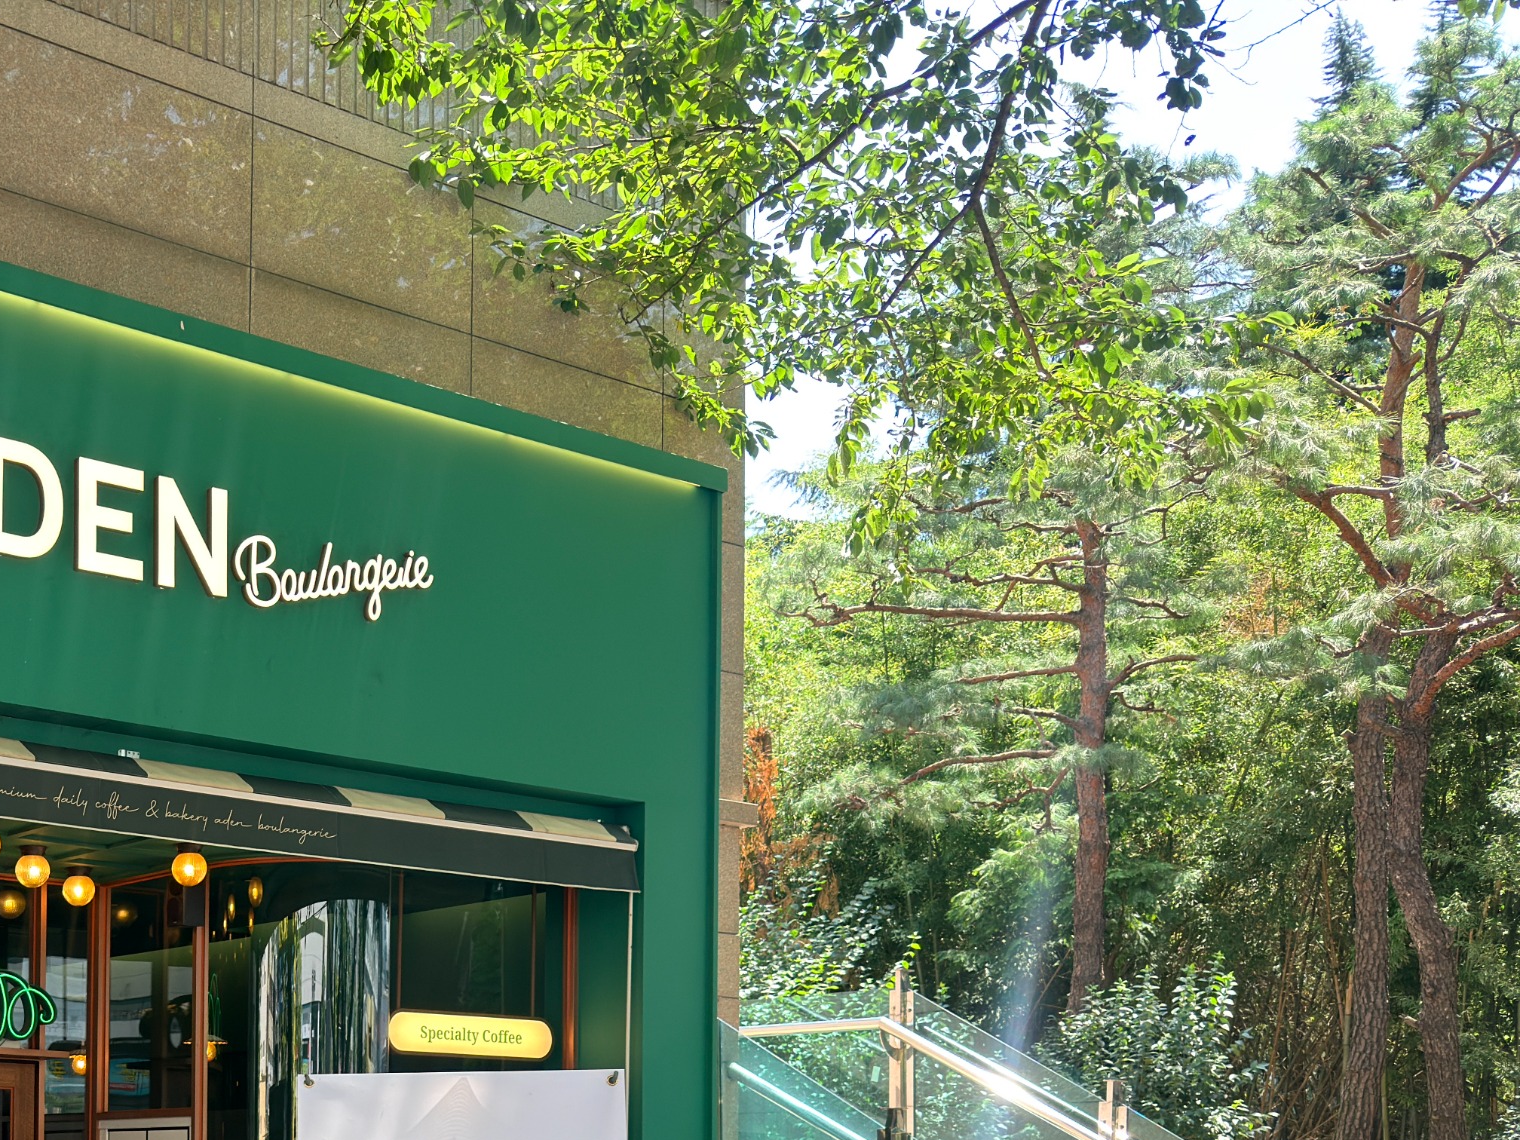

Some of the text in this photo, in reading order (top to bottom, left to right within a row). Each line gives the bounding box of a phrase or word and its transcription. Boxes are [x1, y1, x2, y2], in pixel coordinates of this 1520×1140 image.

[234, 534, 434, 622] Boulangerie
[53, 787, 88, 816] daily
[95, 791, 140, 820] coffee
[145, 800, 159, 818] &
[165, 801, 209, 827] bakery
[214, 810, 253, 830] aden
[257, 814, 337, 845] boulangerie
[420, 1025, 523, 1046] Specialty Coffee
